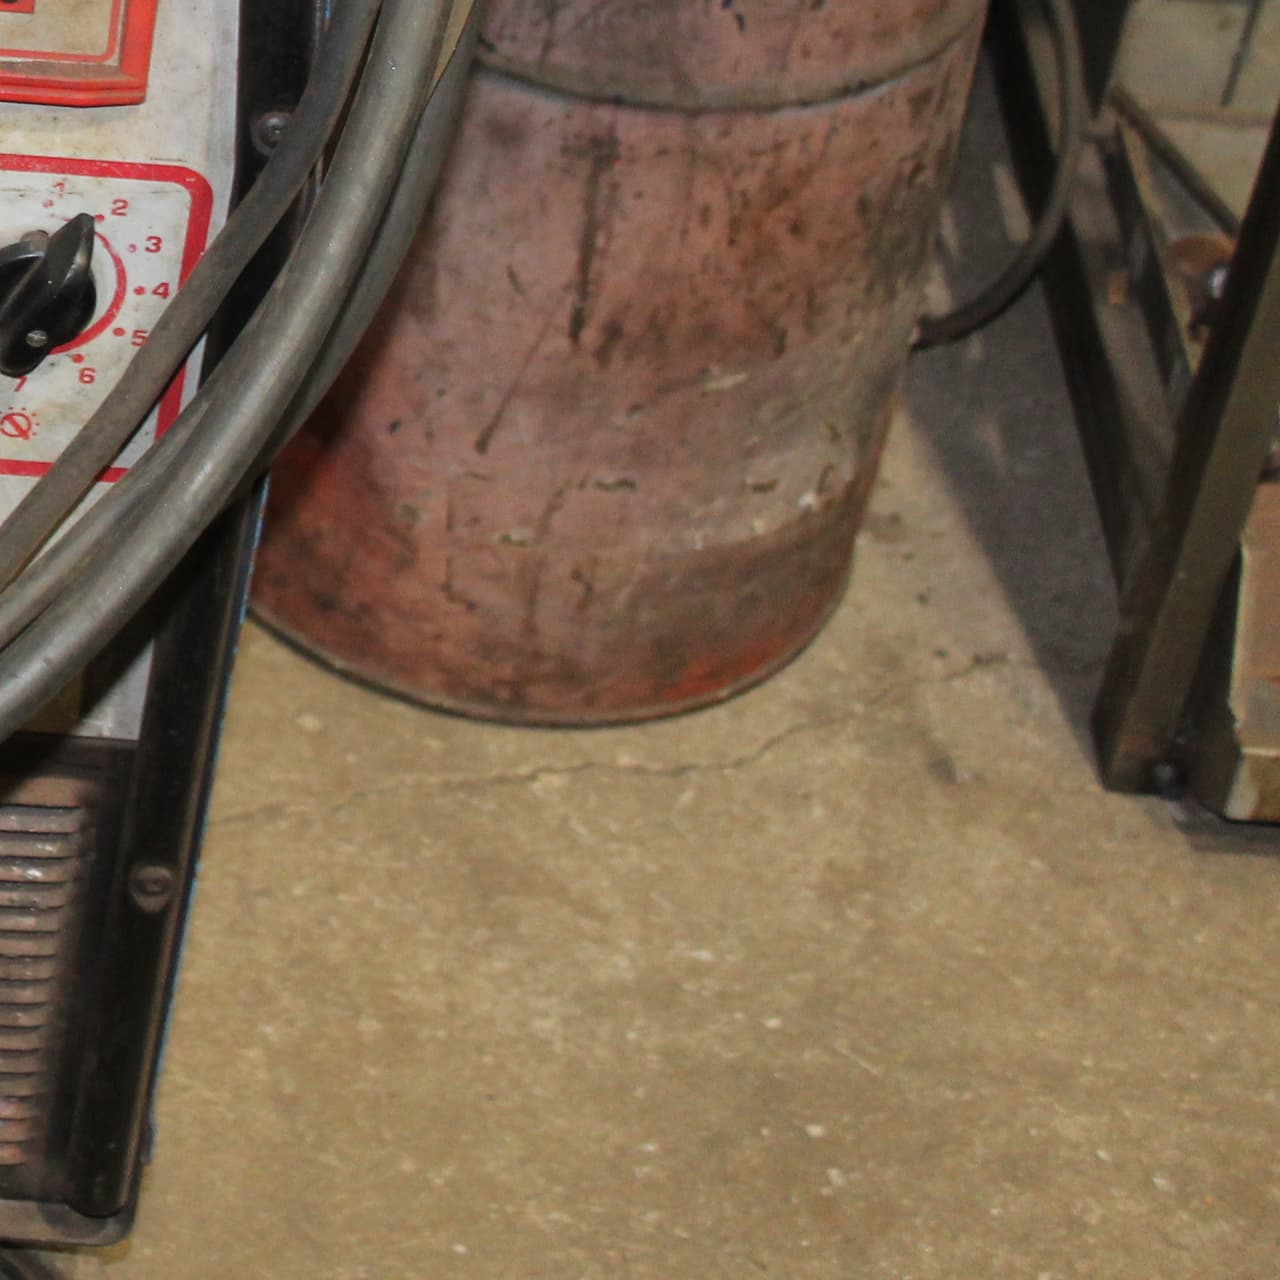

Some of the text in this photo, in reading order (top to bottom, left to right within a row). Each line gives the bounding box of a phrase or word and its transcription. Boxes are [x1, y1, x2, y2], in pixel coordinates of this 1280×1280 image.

[110, 199, 129, 217] 2
[144, 236, 163, 254] 3
[151, 282, 171, 300] 4
[131, 329, 150, 348] 5
[78, 367, 97, 385] 6
